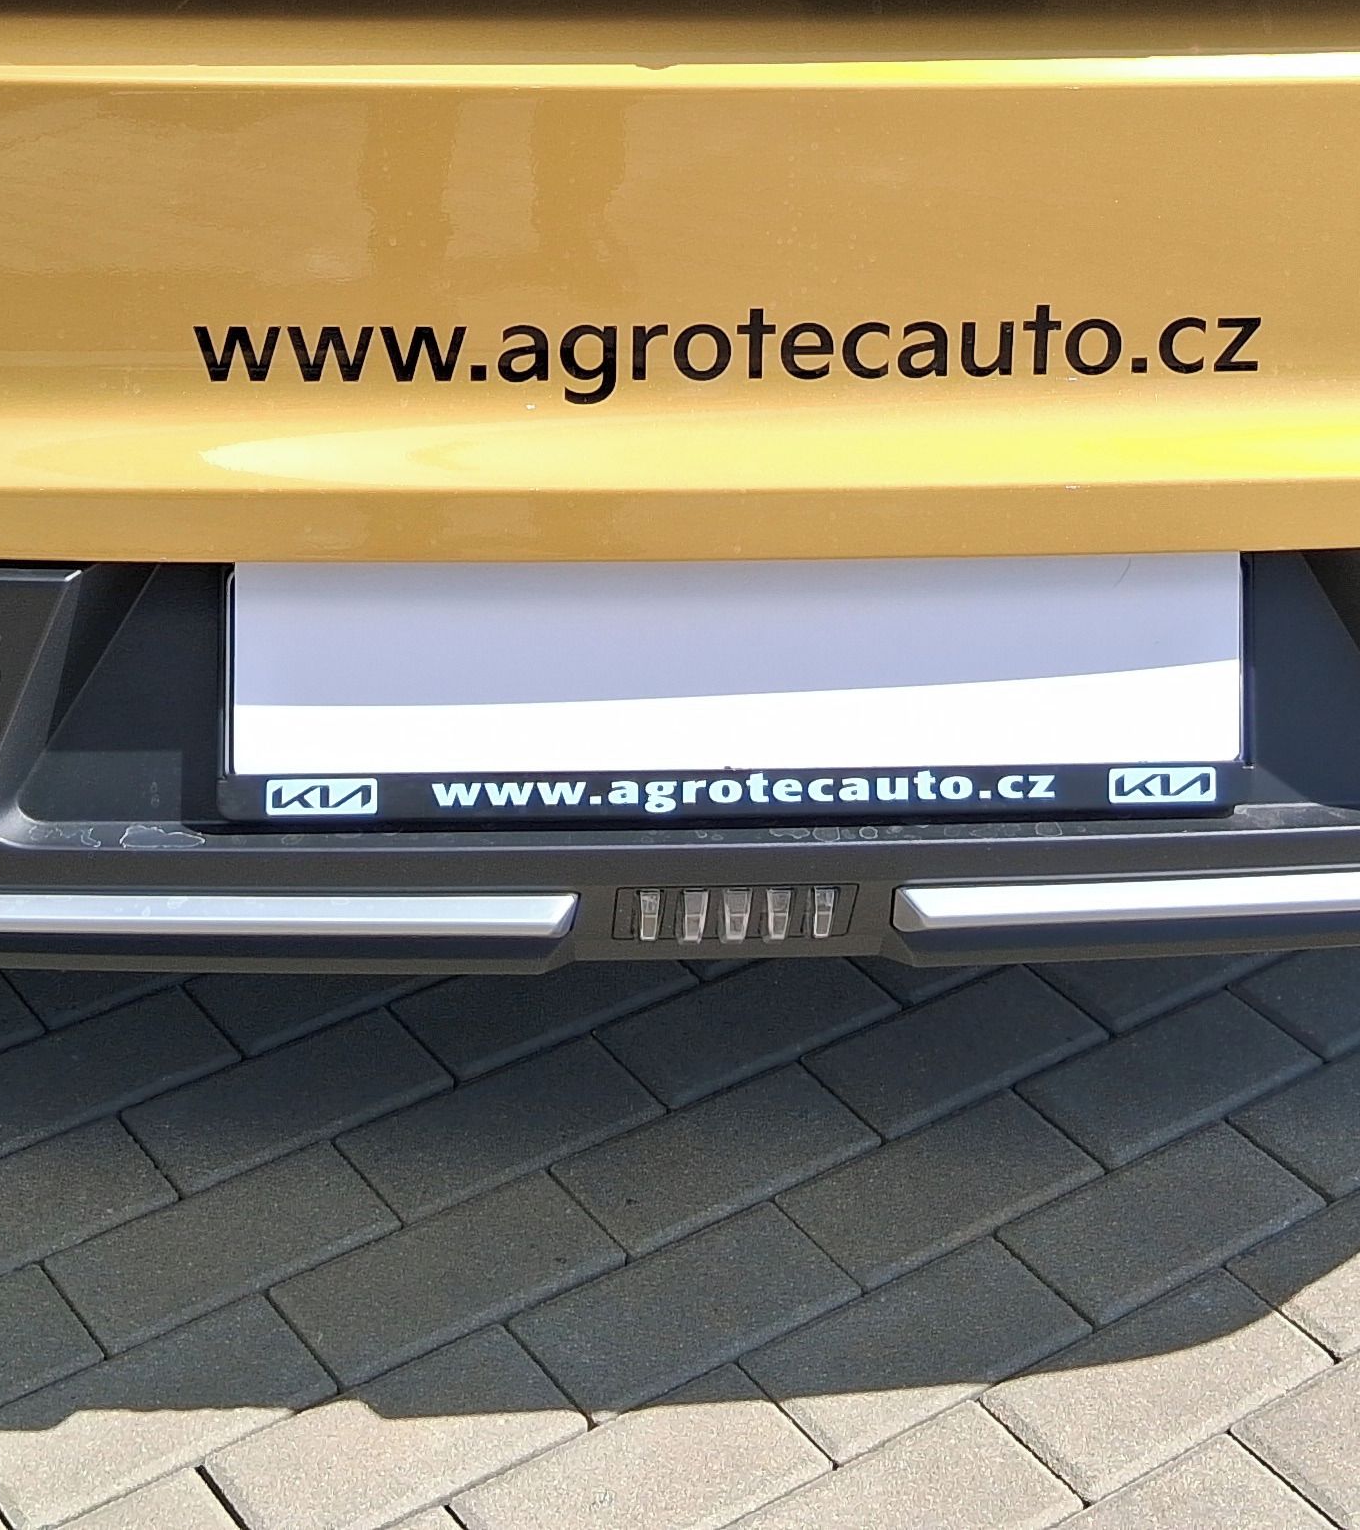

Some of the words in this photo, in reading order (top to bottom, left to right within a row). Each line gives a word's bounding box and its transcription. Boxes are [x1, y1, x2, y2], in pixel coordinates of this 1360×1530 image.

[193, 303, 1262, 405] www.agrotecauto.cz
[271, 784, 373, 809] KIA
[431, 770, 1056, 813] www.agrotecauto.cz
[1114, 773, 1212, 797] KIA
